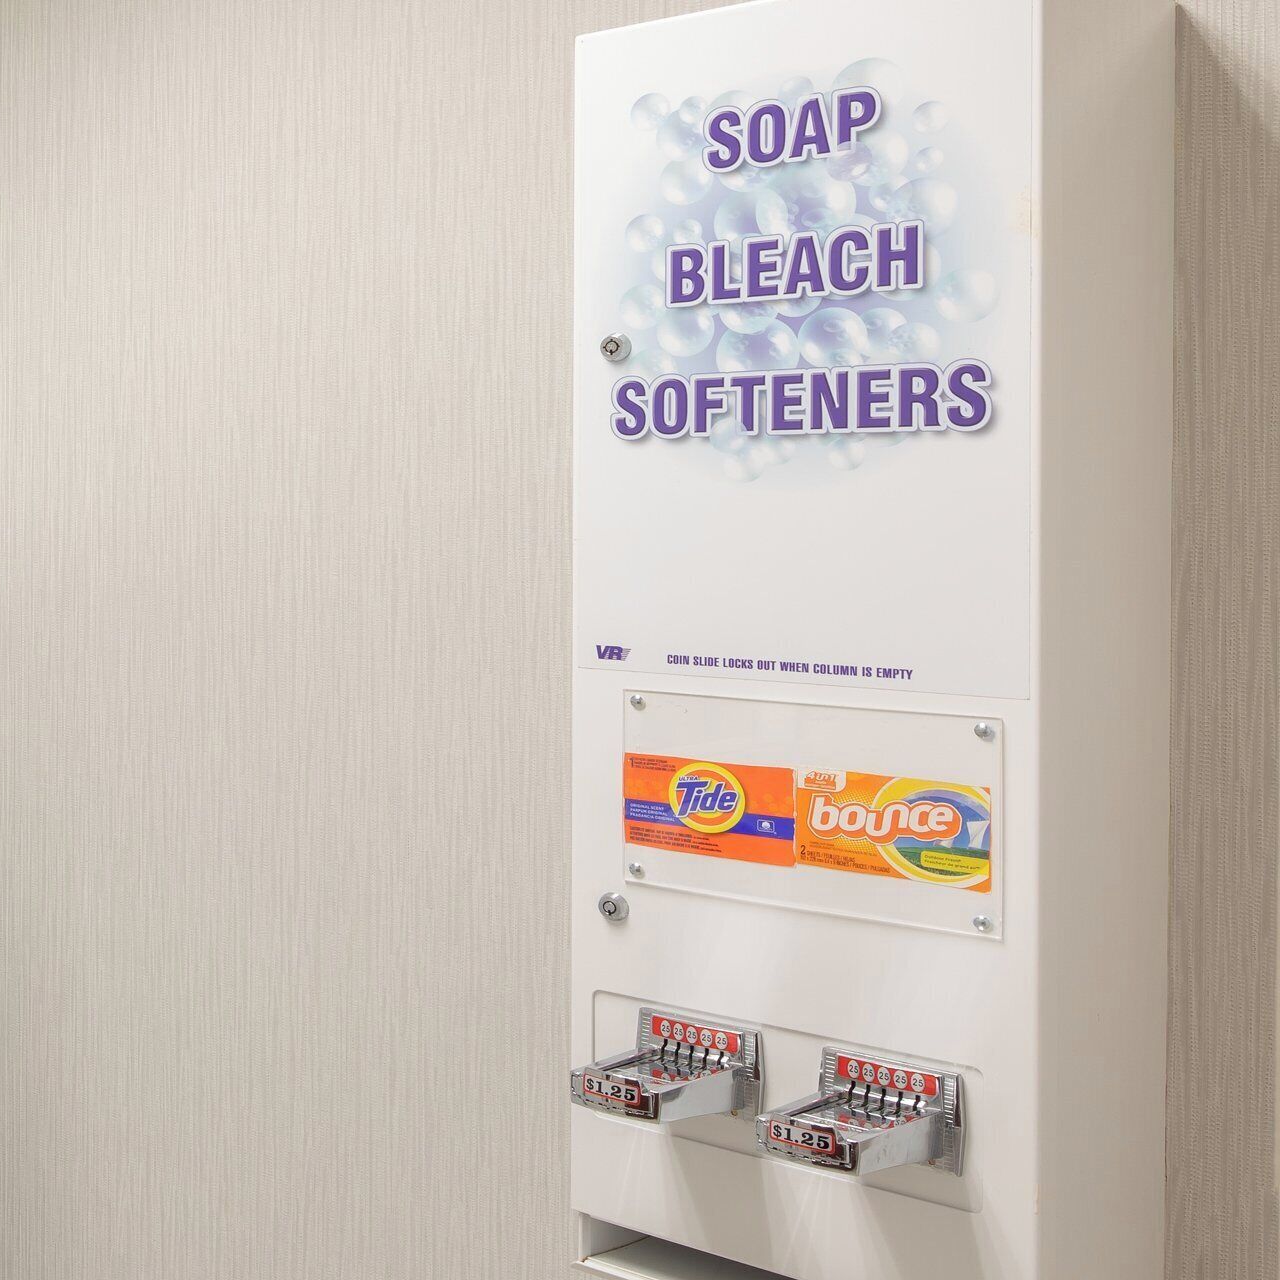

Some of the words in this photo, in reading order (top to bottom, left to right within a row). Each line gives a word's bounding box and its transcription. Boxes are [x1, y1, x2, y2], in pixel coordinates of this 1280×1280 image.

[707, 90, 877, 169] SOAP
[669, 224, 919, 304] BLEACH
[615, 364, 988, 436] SOFTENERS
[667, 654, 689, 665] COIN
[693, 656, 719, 667] SLIDE
[723, 658, 753, 669] LOCKS
[757, 660, 776, 671] OUT
[779, 661, 809, 673] WHEN
[813, 663, 858, 676] COLUMN
[862, 666, 872, 677] IS
[876, 667, 913, 680] EMPTY
[676, 781, 738, 817] Tide
[811, 797, 954, 837] bounce
[801, 845, 806, 855] 2
[688, 1031, 697, 1039] 25
[702, 1034, 711, 1042] 25
[717, 1037, 727, 1045] 25
[849, 1065, 859, 1074] 25
[864, 1068, 874, 1076] 25
[879, 1071, 889, 1080] 25
[895, 1075, 906, 1083] 25
[913, 1078, 924, 1087] 25
[586, 1078, 636, 1101] $1.25
[772, 1124, 830, 1149] $1.25
